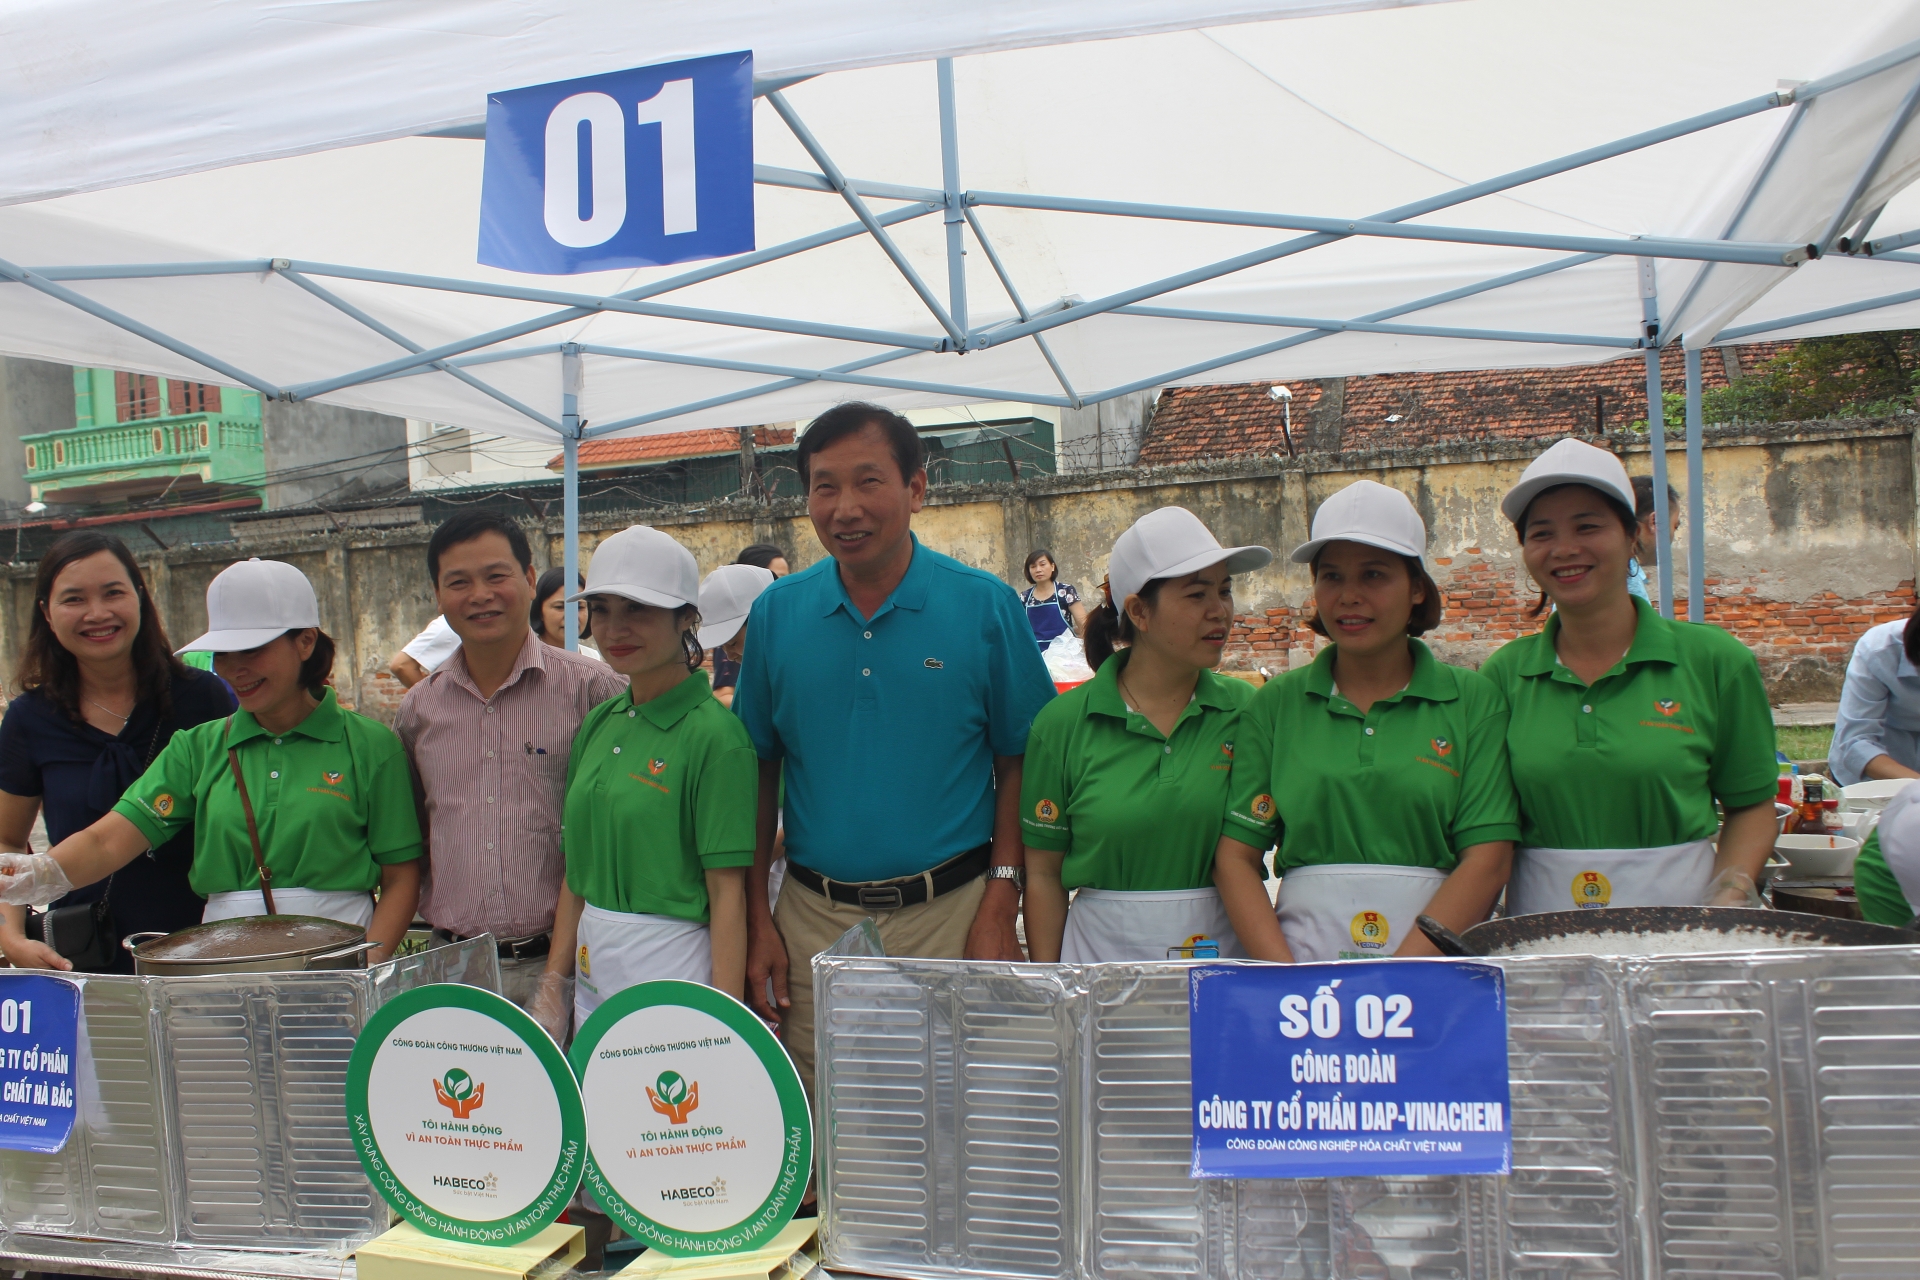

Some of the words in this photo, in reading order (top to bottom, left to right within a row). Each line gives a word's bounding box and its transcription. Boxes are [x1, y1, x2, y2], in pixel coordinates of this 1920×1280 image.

[544, 77, 697, 248] 01
[1, 998, 32, 1034] 01
[1279, 979, 1342, 1039] SỐ
[1355, 993, 1413, 1039] 02
[392, 1038, 413, 1047] CÔNG
[415, 1040, 435, 1049] ĐOÀN
[437, 1041, 458, 1050] CÔNG
[460, 1043, 489, 1053] THƯƠNG
[490, 1044, 504, 1055] VIỆT
[505, 1046, 522, 1055] NAM
[599, 1049, 621, 1059] CÔNG
[623, 1046, 643, 1057] ĐOÀN
[645, 1044, 666, 1054] CÔNG
[667, 1041, 697, 1052] THƯƠNG
[698, 1037, 713, 1049] VIỆT
[714, 1036, 731, 1046] NAM
[8, 1049, 21, 1069] TY
[23, 1043, 39, 1071] CỔ
[40, 1046, 69, 1074] PHẦN
[1291, 1048, 1341, 1084] CÔNG
[1345, 1048, 1396, 1084] ĐOÀN
[3, 1076, 32, 1104] CHẤT
[33, 1081, 48, 1105] HÀ
[51, 1081, 73, 1108] BẮC
[3, 1113, 20, 1124] CHẤT
[20, 1115, 34, 1127] VIỆT
[32, 1117, 47, 1127] NAM
[1199, 1094, 1247, 1129] CÔNG
[1251, 1100, 1272, 1129] TY
[1277, 1089, 1302, 1130] CỔ
[1306, 1091, 1356, 1131] PHẦN
[1361, 1101, 1503, 1132] DAP-VINACHEM
[422, 1119, 438, 1129] TÔI
[440, 1121, 469, 1132] HÀNH
[471, 1123, 503, 1136] ĐỘNG
[641, 1130, 657, 1142] TÔI
[660, 1128, 689, 1140] HÀNH
[691, 1125, 723, 1138] ĐỘNG
[405, 1132, 415, 1142] VÌ
[418, 1135, 432, 1143] AN
[434, 1135, 461, 1146] TOÀN
[463, 1138, 490, 1150] THỰC
[493, 1138, 523, 1152] PHẨM
[626, 1148, 637, 1159] VÌ
[640, 1148, 654, 1158] AN
[656, 1144, 684, 1156] TOÀN
[685, 1142, 713, 1154] THỰC
[715, 1136, 747, 1151] PHẨM
[786, 1126, 802, 1164] PHẨM
[1226, 1137, 1255, 1150] CÔNG
[1257, 1137, 1286, 1150] ĐOÀN
[1287, 1138, 1317, 1151] CÔNG
[1320, 1138, 1358, 1153] NGHIỆP
[1360, 1138, 1382, 1152] HÓA
[1383, 1138, 1411, 1152] CHẤT
[1413, 1139, 1436, 1154] VIỆT
[1438, 1141, 1462, 1152] NAM
[354, 1113, 368, 1136] XÂY
[380, 1171, 407, 1204] CỘNG
[405, 1201, 438, 1227] ĐỒNG
[438, 1221, 468, 1239] HÀNH
[470, 1228, 504, 1242] ĐỘNG
[504, 1223, 516, 1236] VÌ
[516, 1217, 531, 1233] AN
[528, 1197, 553, 1223] TOÀN
[548, 1173, 568, 1201] THỰC
[561, 1140, 579, 1174] PHẨM
[433, 1175, 485, 1190] HABECO
[780, 1163, 797, 1194] THỰC
[661, 1186, 715, 1201] HABECO
[606, 1195, 638, 1227] CỘNG
[762, 1192, 787, 1222] TOÀN
[637, 1221, 672, 1246] ĐỒNG
[740, 1227, 754, 1241] VÌ
[752, 1218, 768, 1236] AN
[674, 1236, 706, 1251] HÀNH
[707, 1235, 743, 1253] ĐỘNG
